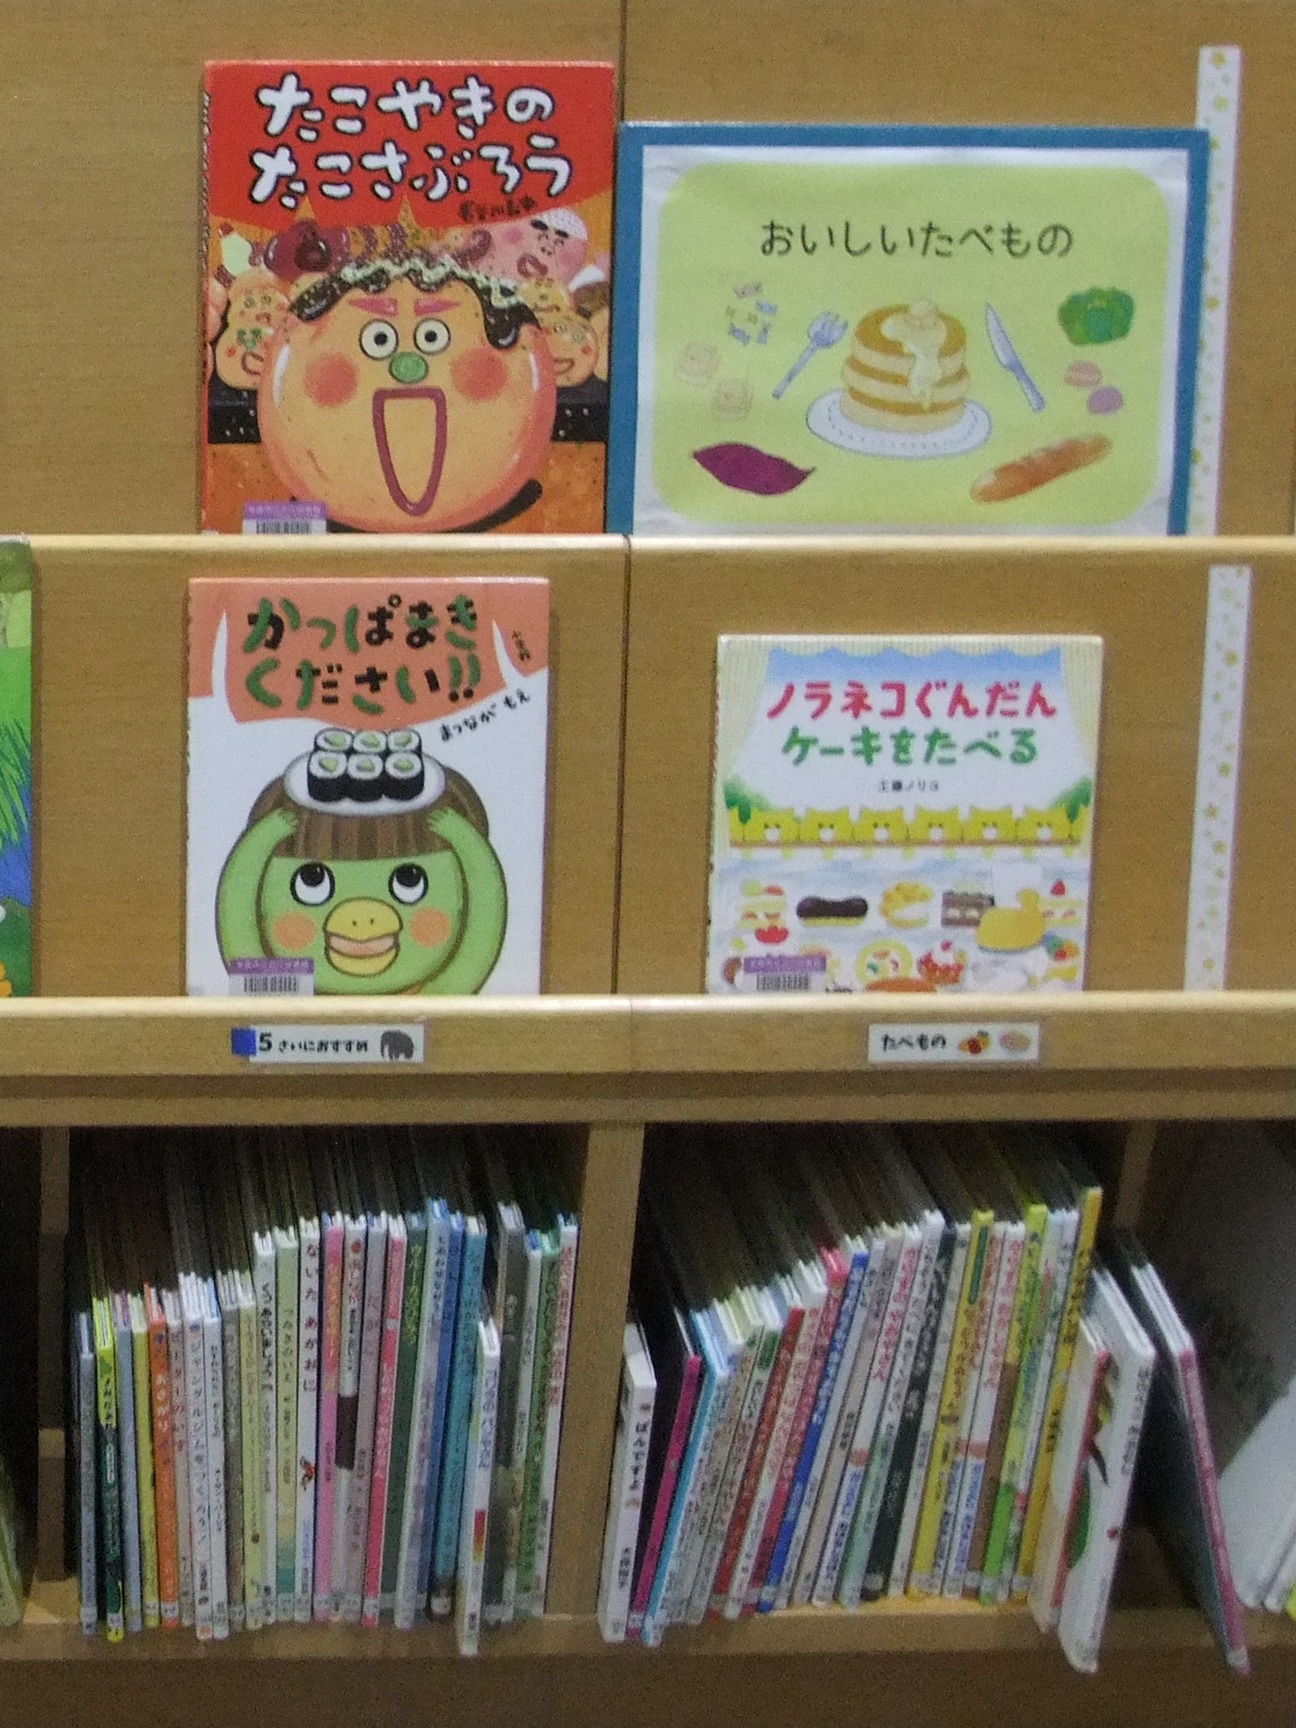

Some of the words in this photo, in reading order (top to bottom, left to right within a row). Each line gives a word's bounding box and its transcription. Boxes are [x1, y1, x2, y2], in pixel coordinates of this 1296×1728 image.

[257, 72, 554, 142] たこやきの
[250, 134, 573, 209] たこさぶろう
[760, 220, 1073, 258] おいしいたべもの
[243, 594, 477, 653] かっぱまき
[767, 680, 1057, 719] ノラネコぐんだん
[782, 725, 1037, 765] ケーキをたべる
[882, 1033, 947, 1052] たべもの
